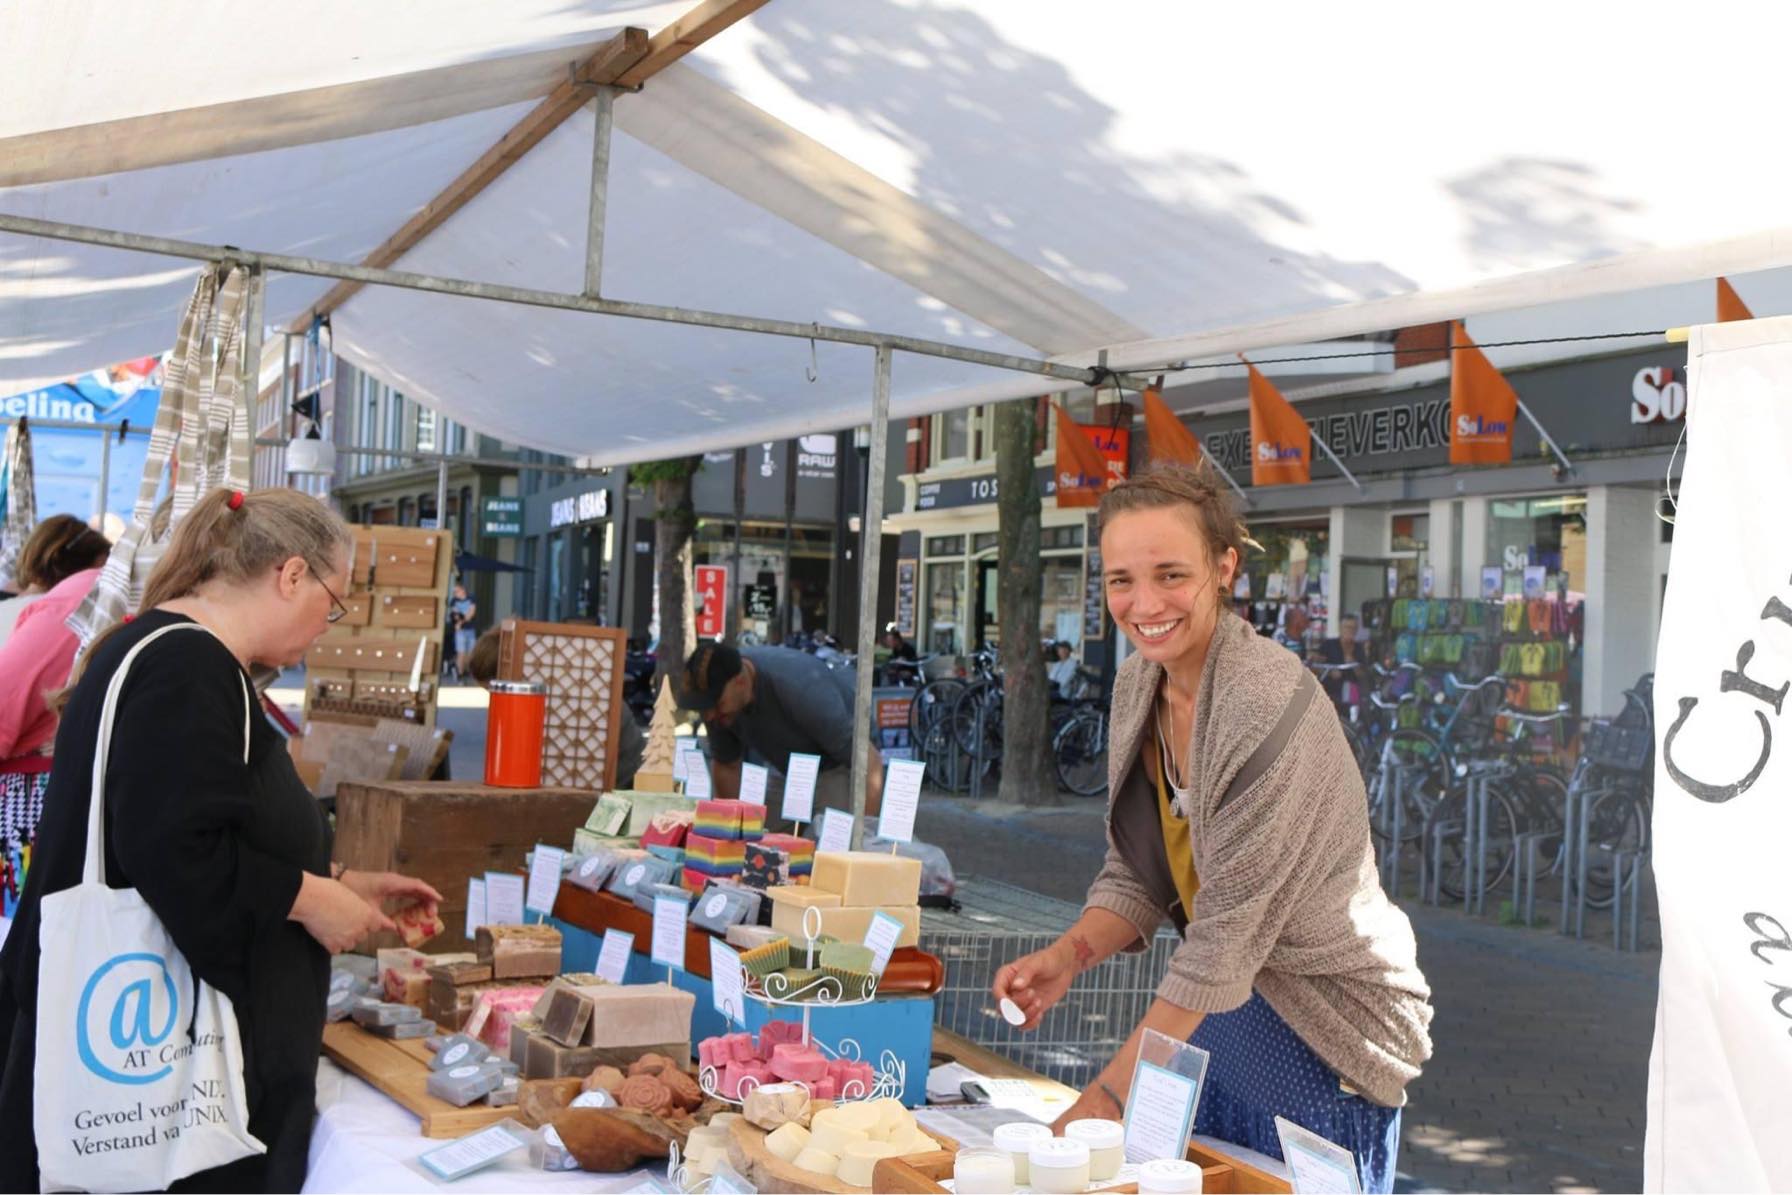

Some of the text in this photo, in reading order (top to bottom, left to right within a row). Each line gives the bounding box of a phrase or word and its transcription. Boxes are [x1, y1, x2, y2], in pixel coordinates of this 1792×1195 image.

[1631, 366, 1685, 424] So
[1457, 414, 1507, 436] SoLow
[798, 453, 836, 468] RAW
[704, 571, 716, 632] SALE
[123, 1050, 152, 1069] AT
[75, 1102, 143, 1130] Gevoel
[150, 1099, 190, 1118] voor
[72, 1126, 157, 1156] Verstand
[163, 1125, 180, 1141] va
